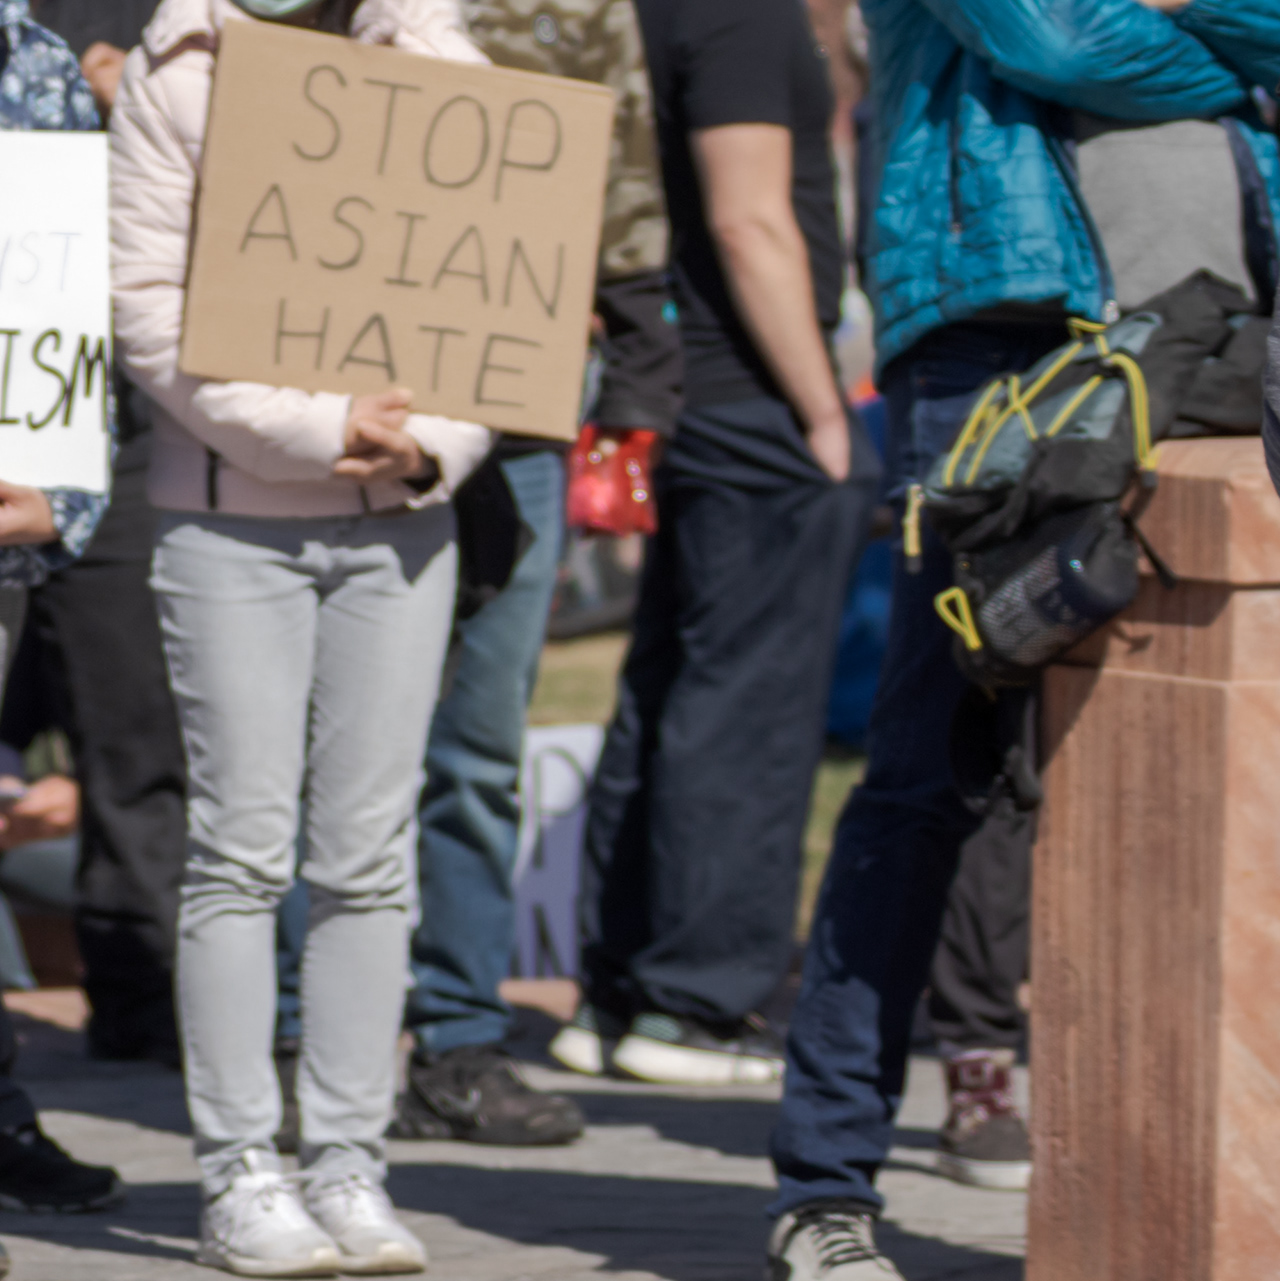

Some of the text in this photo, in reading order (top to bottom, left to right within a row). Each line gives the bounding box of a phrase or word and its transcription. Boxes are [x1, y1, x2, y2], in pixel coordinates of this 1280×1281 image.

[292, 64, 562, 203] STOP
[240, 183, 566, 320] ASIAN
[273, 298, 544, 408] HATE
